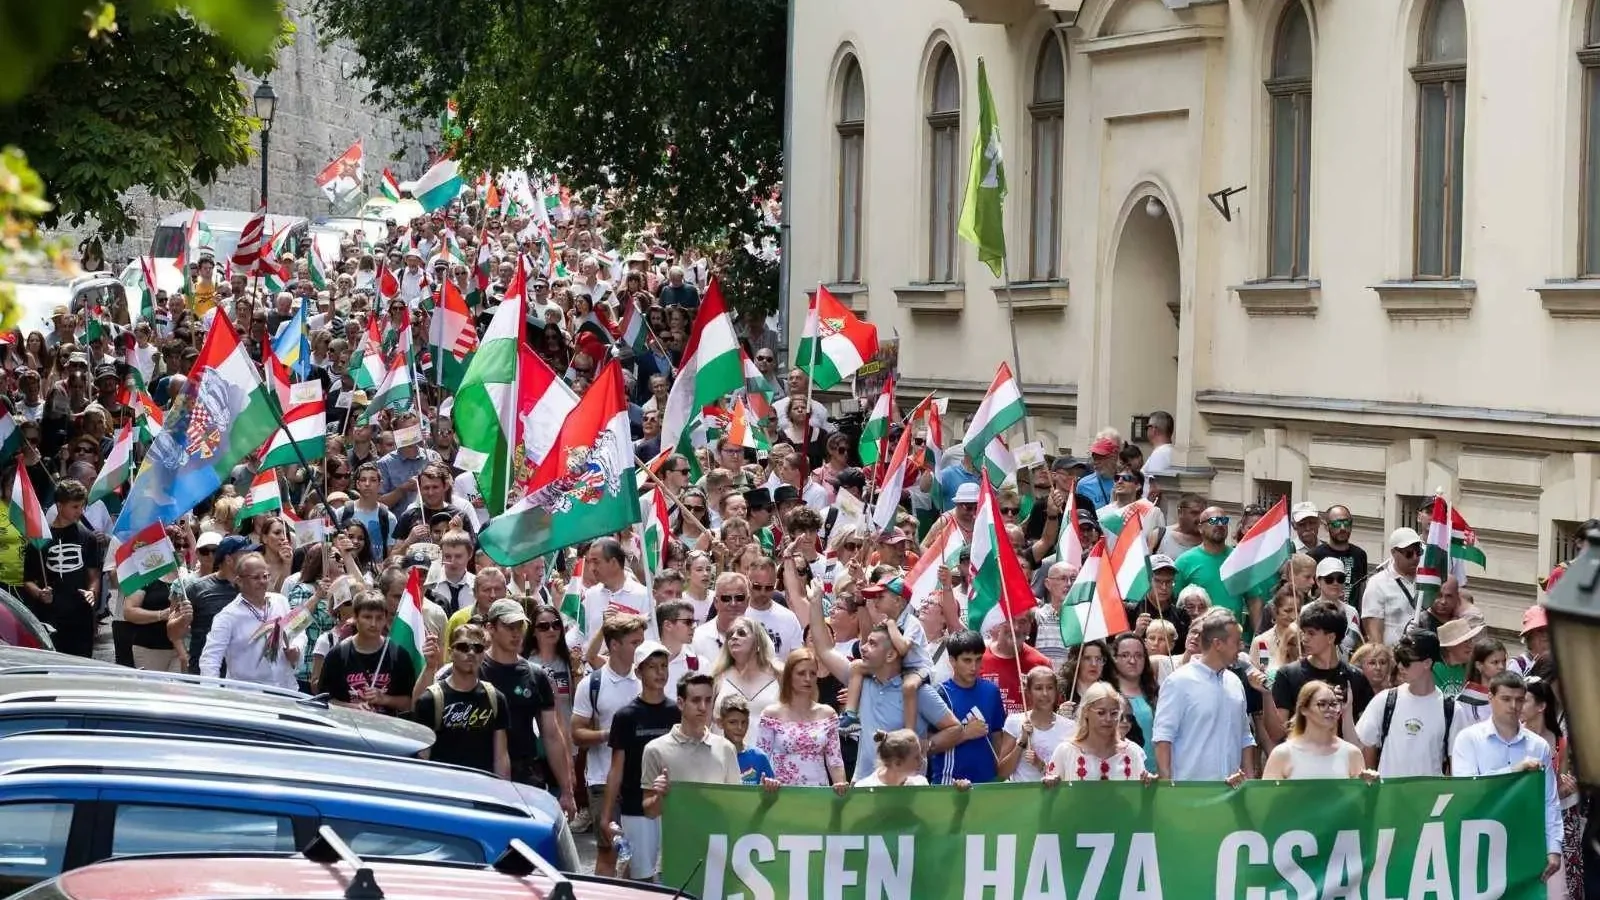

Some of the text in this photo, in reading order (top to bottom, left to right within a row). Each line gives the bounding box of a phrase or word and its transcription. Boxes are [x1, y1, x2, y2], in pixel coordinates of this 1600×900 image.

[703, 793, 1508, 900] ISTEN HAZA CSALÁD
